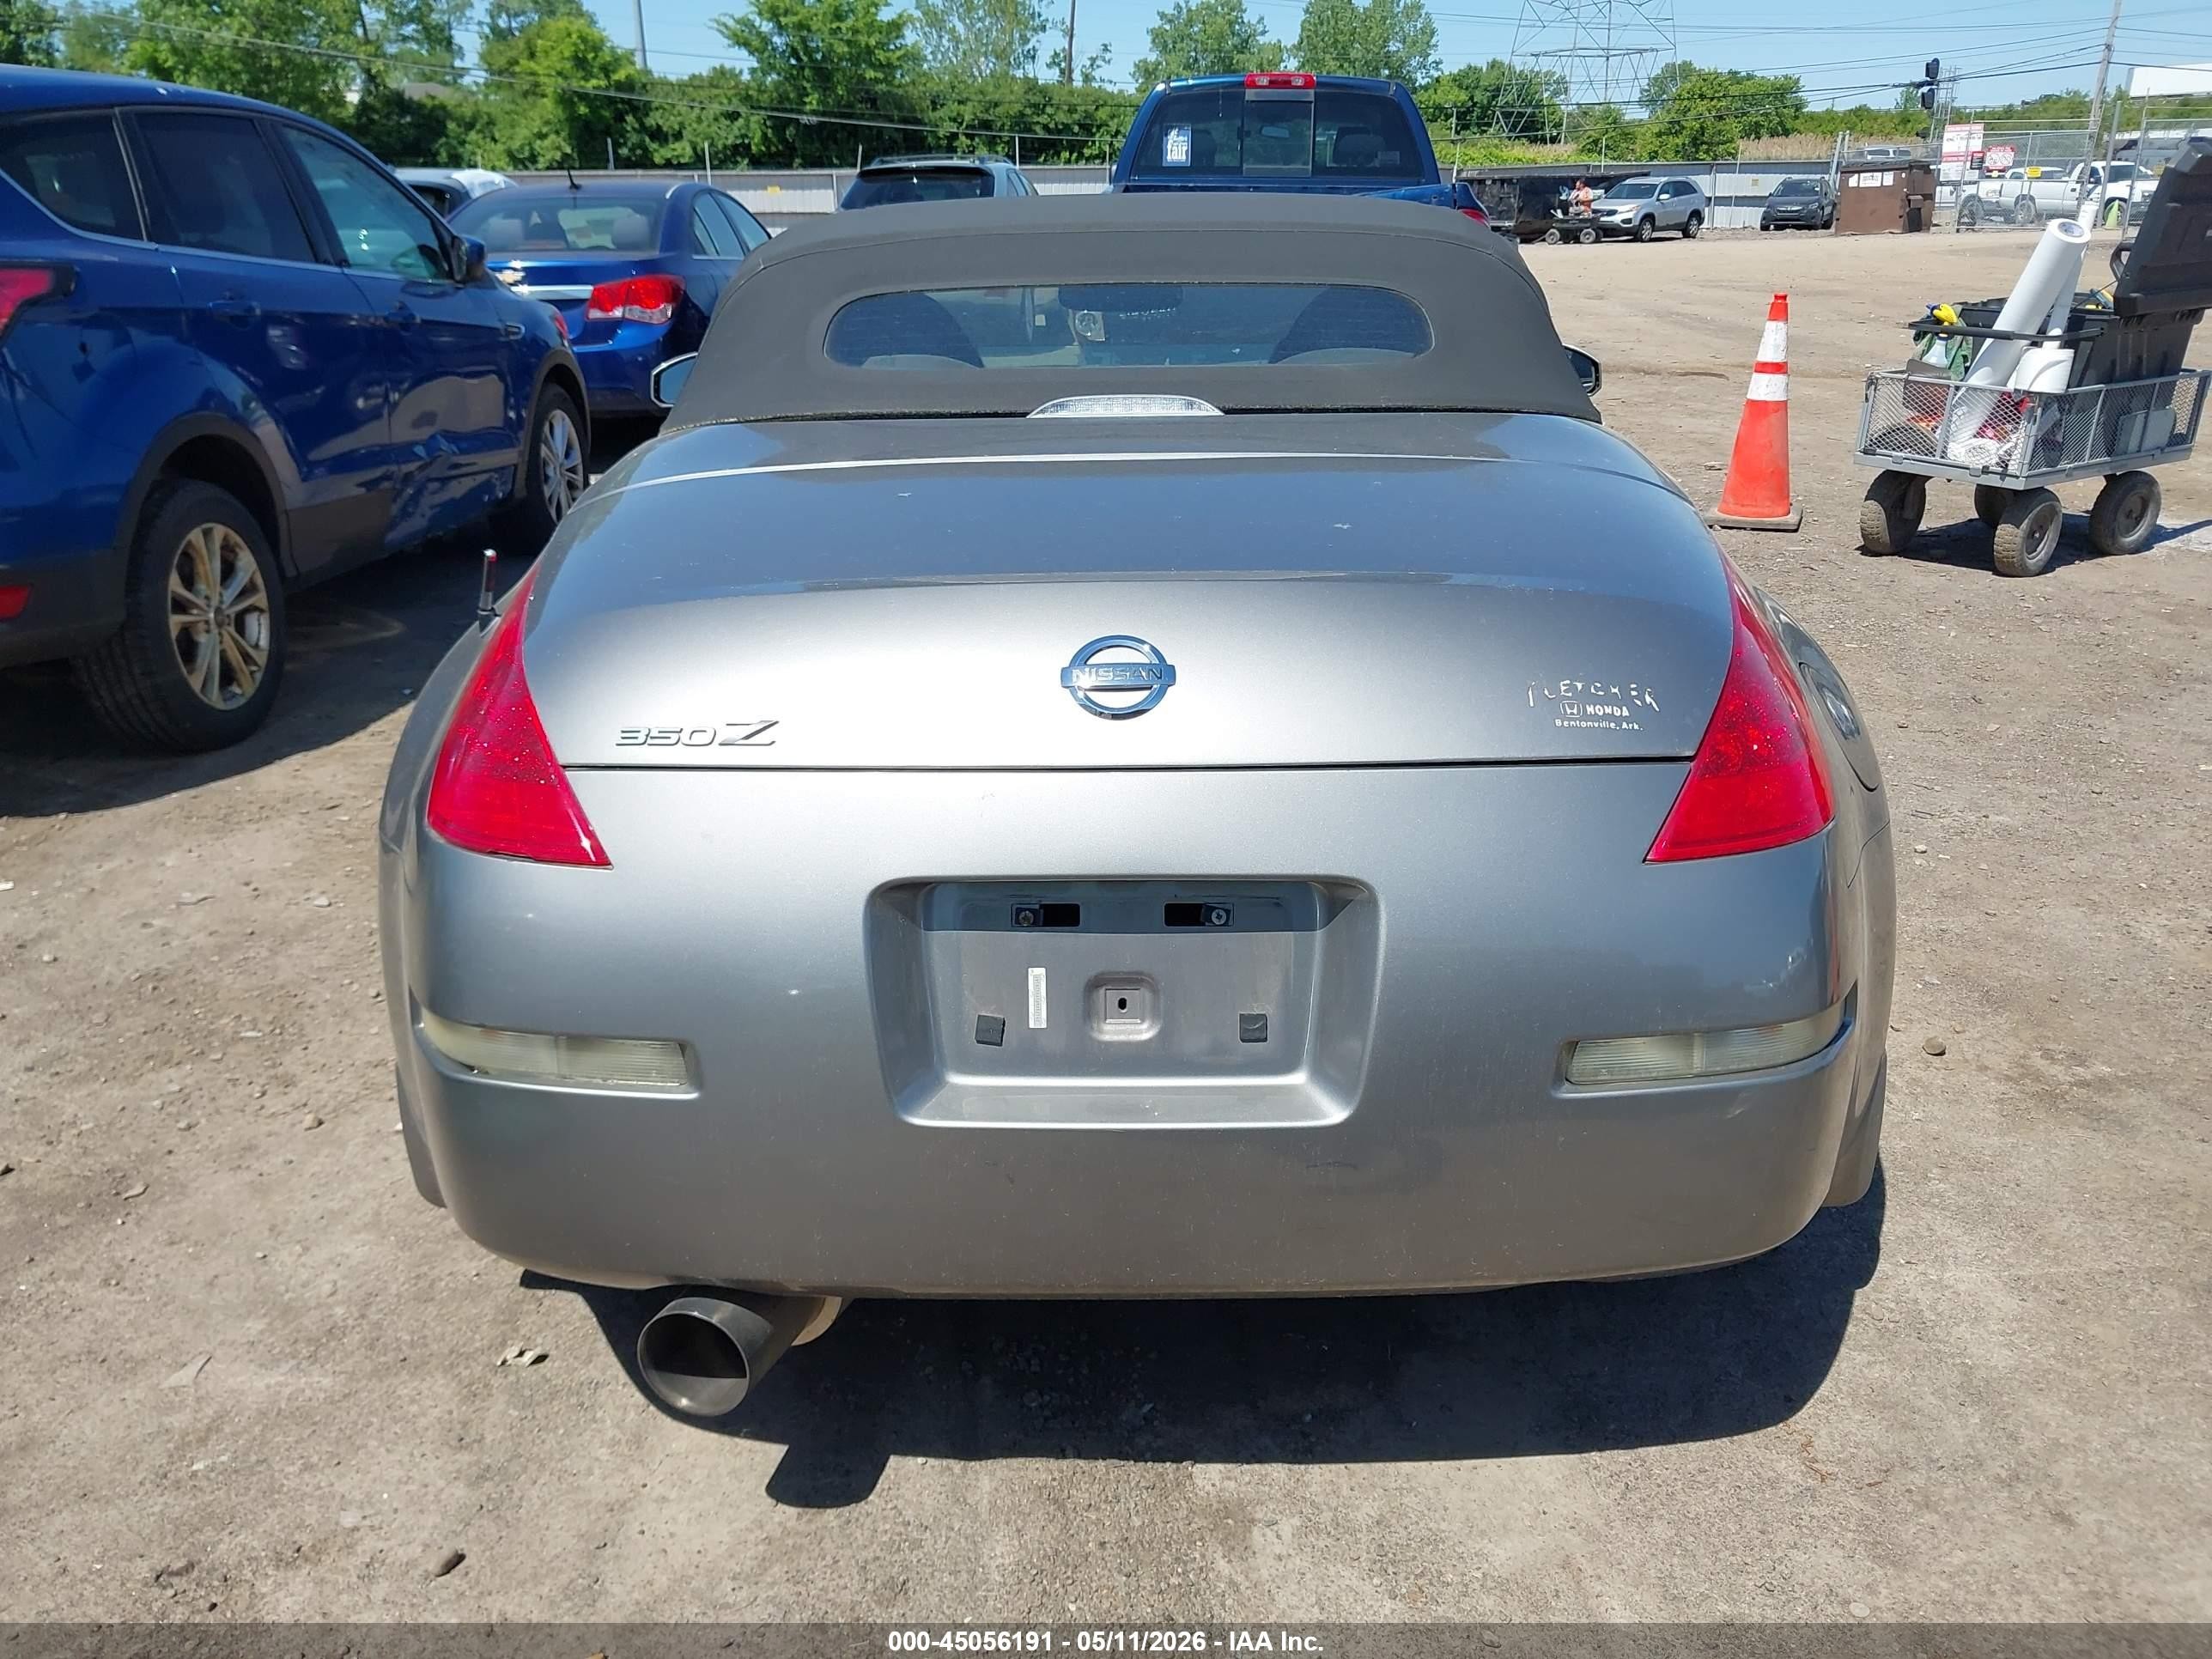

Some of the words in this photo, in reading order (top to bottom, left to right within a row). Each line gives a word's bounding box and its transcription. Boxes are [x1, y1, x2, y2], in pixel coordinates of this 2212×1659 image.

[1073, 666, 1164, 682] NISSAN
[1585, 703, 1630, 717] HONDA
[1554, 719, 1620, 730] Bentonville,
[1621, 720, 1644, 731] Ark.
